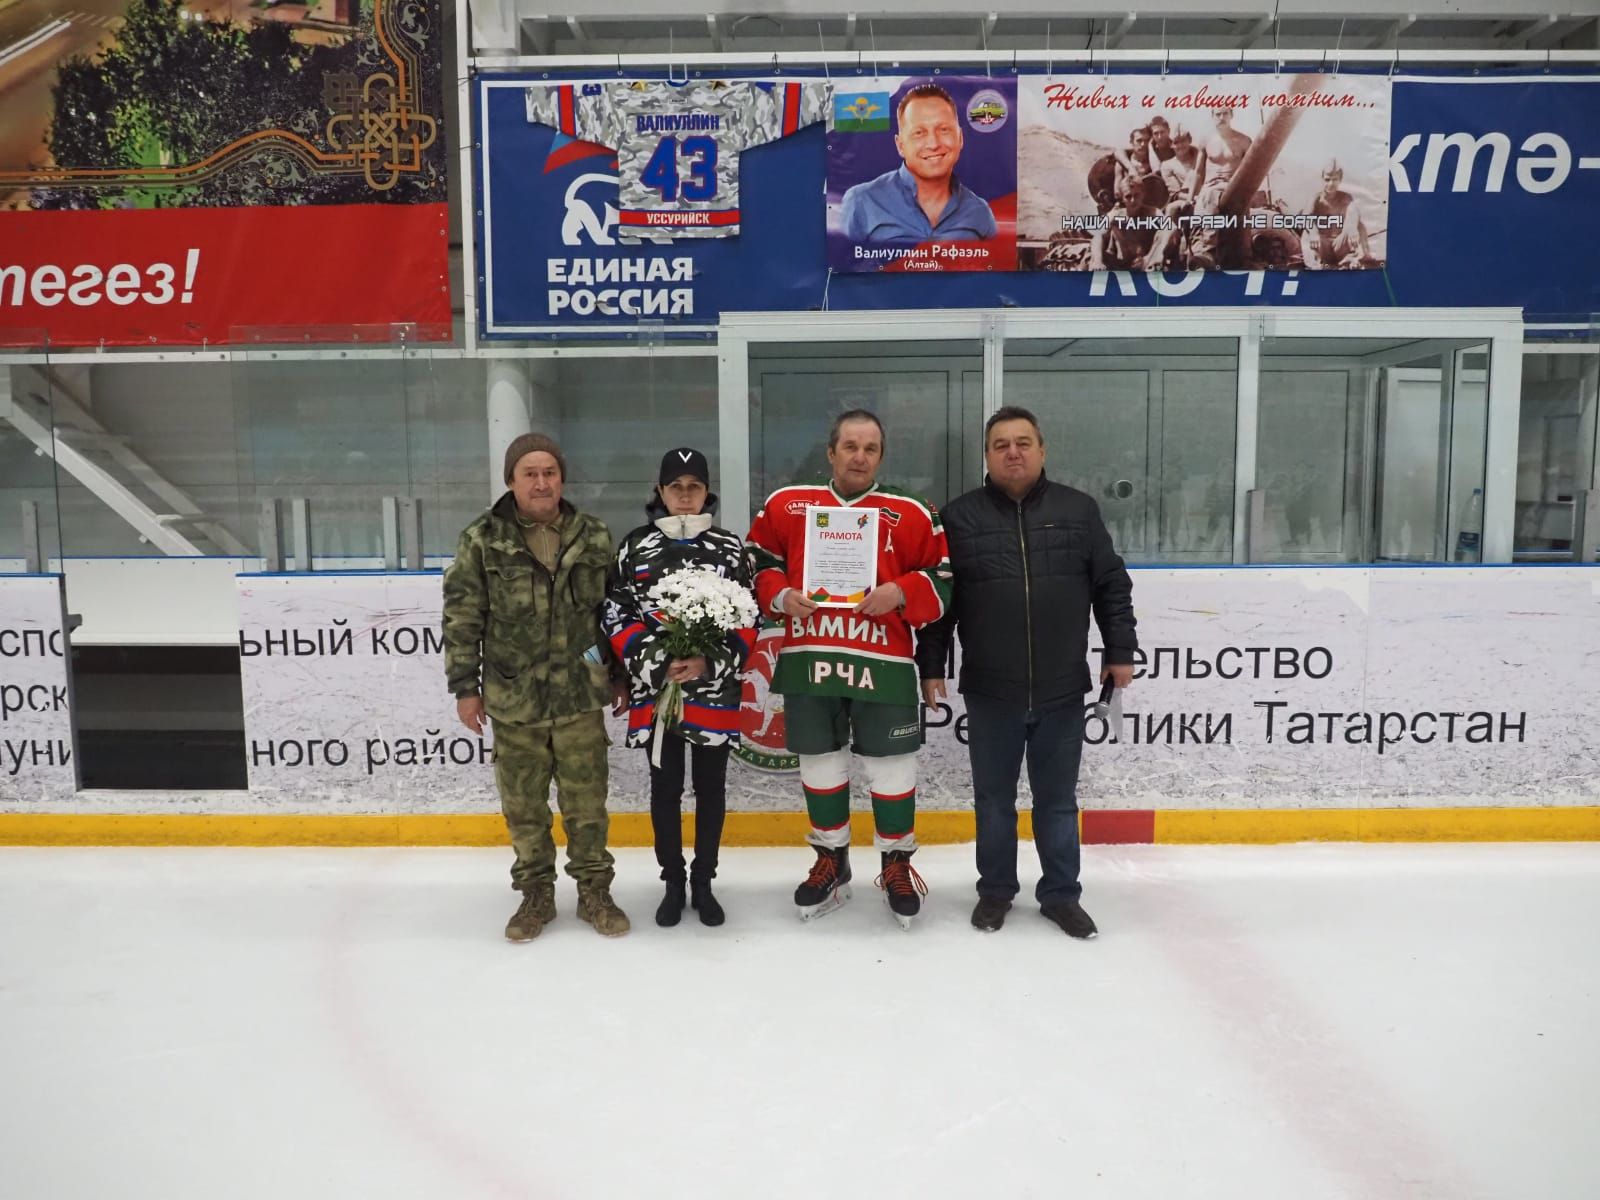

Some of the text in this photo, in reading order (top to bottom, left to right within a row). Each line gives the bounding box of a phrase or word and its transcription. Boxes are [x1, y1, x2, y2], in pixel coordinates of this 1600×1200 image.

[1044, 84, 1375, 111] Живых и павших помним...
[636, 114, 720, 132] ВАЛИУЛЛИН
[639, 135, 718, 202] 43
[646, 212, 710, 225] УССУРИЙСК
[1062, 215, 1343, 230] НАШИ ТАНКИ ГРЯЗИ НЕ БОЯТСЯ!
[854, 244, 989, 260] Валиуллин Рафаэль
[904, 260, 938, 271] (Алтай)
[547, 257, 694, 286] ЕДИНАЯ
[548, 288, 694, 316] РОССИЯ
[820, 531, 862, 541] ГРАМОТА
[791, 616, 888, 647] ВАМИН
[1254, 701, 1527, 755] Татарстан
[253, 739, 349, 767] ного
